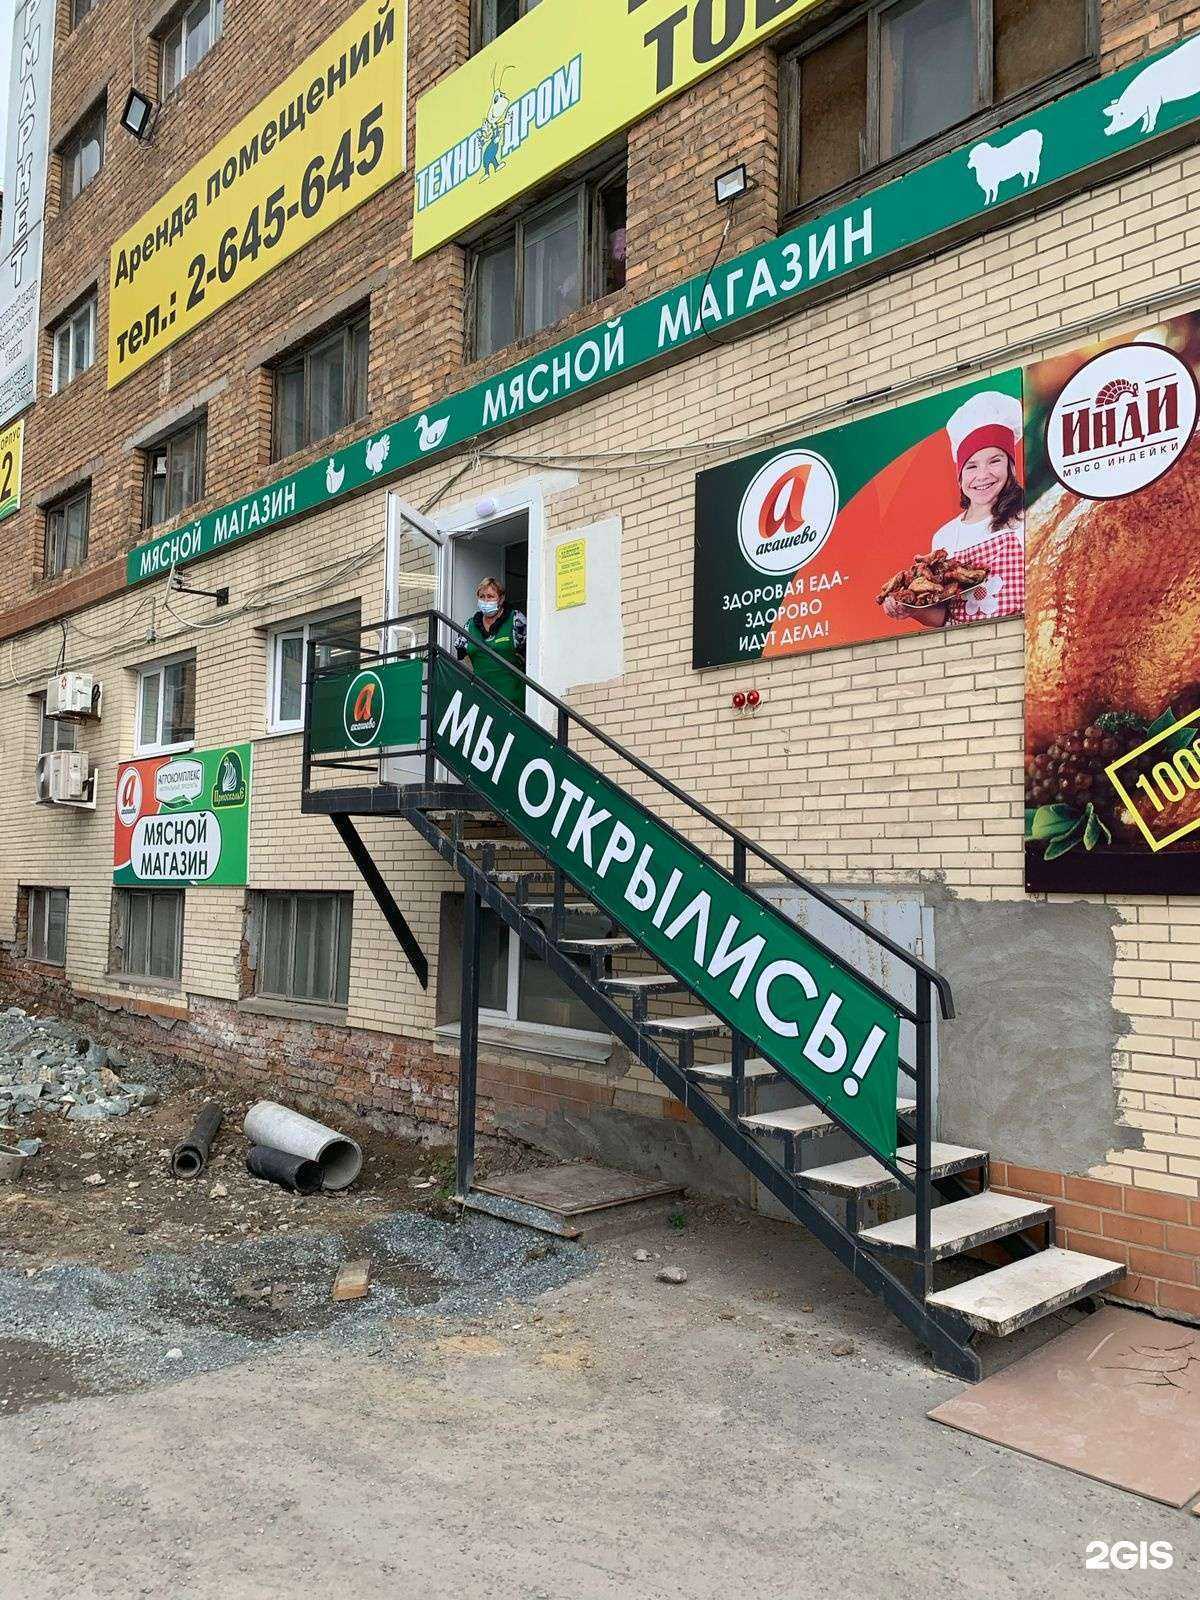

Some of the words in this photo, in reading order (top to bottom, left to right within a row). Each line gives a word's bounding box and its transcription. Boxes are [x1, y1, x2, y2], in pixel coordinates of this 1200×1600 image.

[643, 0, 798, 95] ТО
[115, 193, 197, 288] Аренда
[206, 0, 395, 206] помещений
[116, 291, 176, 363] тел.:
[186, 103, 384, 312] 2-645-645
[481, 316, 625, 426] МЯСНОЙ
[658, 208, 872, 348] МАГАЗИН
[1062, 382, 1179, 457] ИНДИ
[0, 451, 13, 502] 2
[1062, 463, 1101, 478] МЯСО
[1108, 442, 1179, 467] ИНДЕЙКИ
[139, 522, 202, 576] МЯСНОЙ
[213, 482, 296, 544] МАГАЗИН
[755, 525, 817, 556] акашево
[722, 578, 804, 611] ЗДОРОВАЯ
[745, 599, 822, 628] ЗДОРОВО
[739, 630, 776, 652] ИДУТ
[780, 619, 829, 645] ДЕЛА!
[1135, 737, 1200, 812] 100
[143, 812, 207, 846] МЯСНОЙ
[140, 851, 208, 876] МАГАЗИН
[436, 689, 515, 784] МЫ
[517, 757, 887, 1097] ОТКРЫЛИСЬ!
